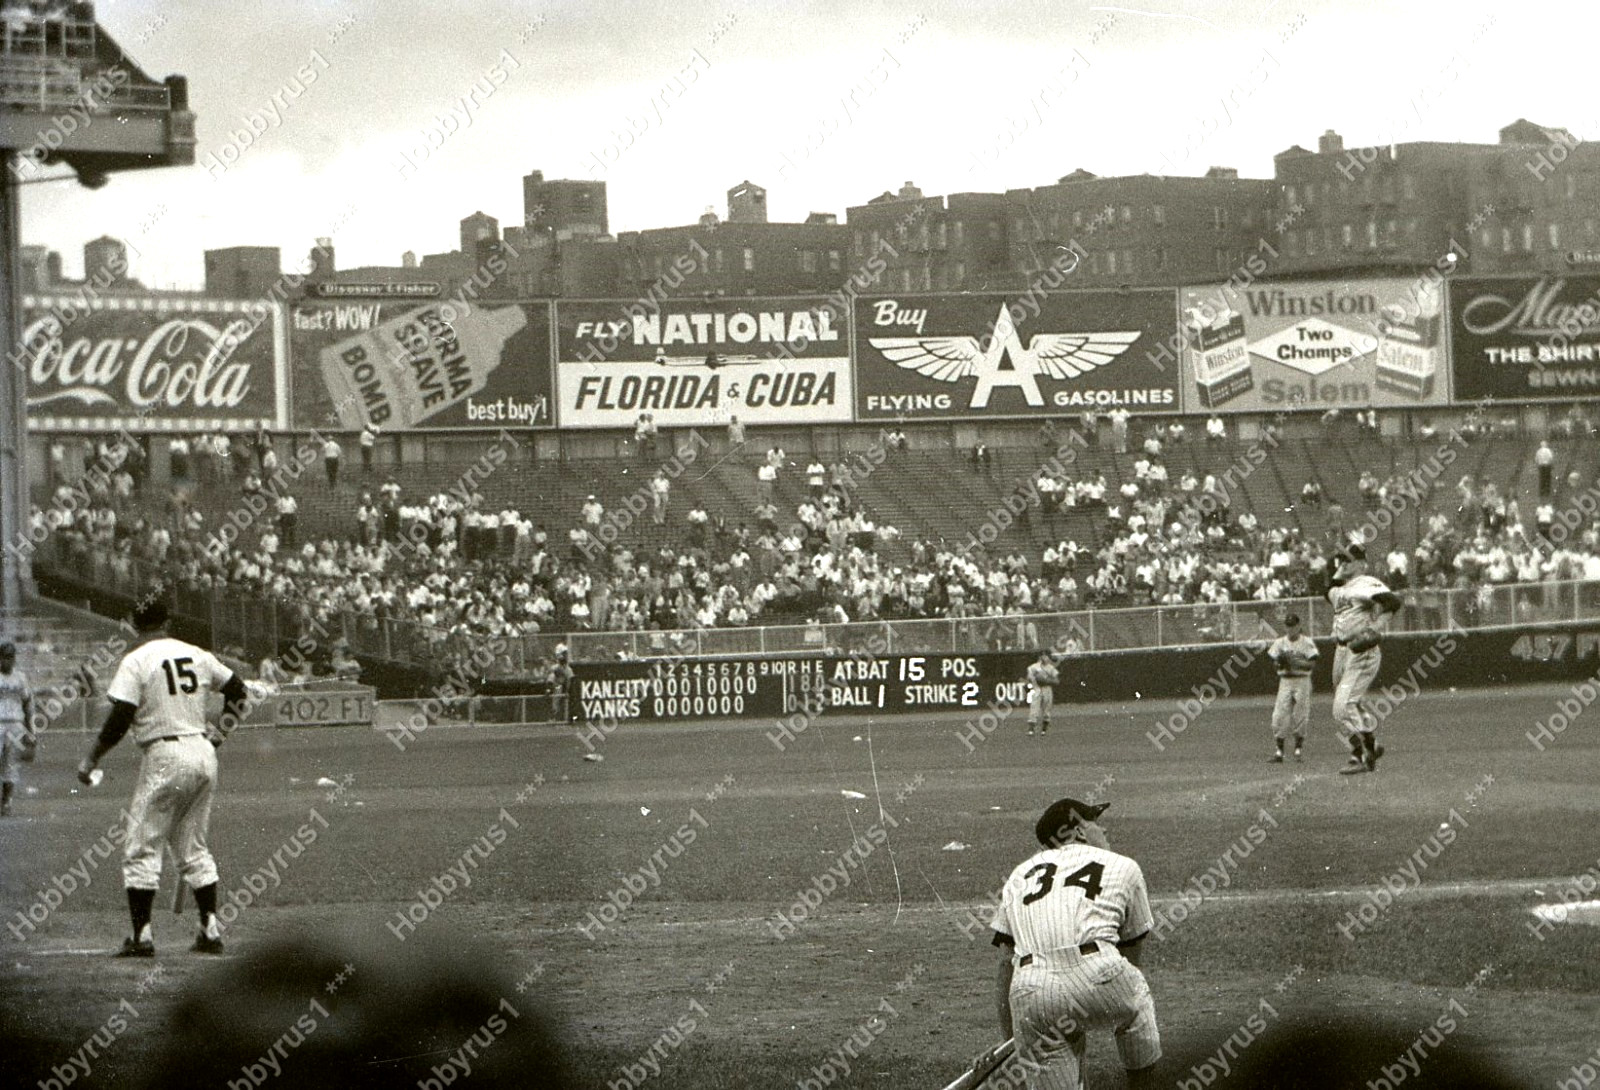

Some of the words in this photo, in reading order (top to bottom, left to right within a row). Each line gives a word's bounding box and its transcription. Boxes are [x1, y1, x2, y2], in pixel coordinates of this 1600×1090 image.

[335, 302, 382, 331] WOW!
[873, 299, 928, 334] Buy
[1245, 289, 1376, 317] Winston
[575, 320, 628, 338] FLY
[632, 310, 839, 345] NATIONAL
[1296, 327, 1334, 341] Two
[1276, 344, 1353, 363] Champs
[341, 344, 392, 425] BOMB
[574, 374, 720, 410] FLORIDA
[727, 382, 741, 399] &
[745, 371, 836, 408] CUBA
[1261, 378, 1370, 404] Salem
[467, 396, 505, 420] best
[508, 396, 548, 425] buy!
[867, 394, 952, 411] FLYING
[1053, 388, 1174, 407] GASOLINES
[162, 657, 198, 695] 15
[899, 657, 926, 681] 15
[942, 657, 980, 678] POS.
[832, 686, 872, 706] BALL
[878, 684, 885, 708] 1
[905, 684, 957, 704] STRIKE
[961, 681, 979, 706] 2
[995, 682, 1025, 702] OUT
[280, 698, 329, 721] 402
[581, 699, 641, 719] YANKS
[1022, 861, 1105, 906] 34
